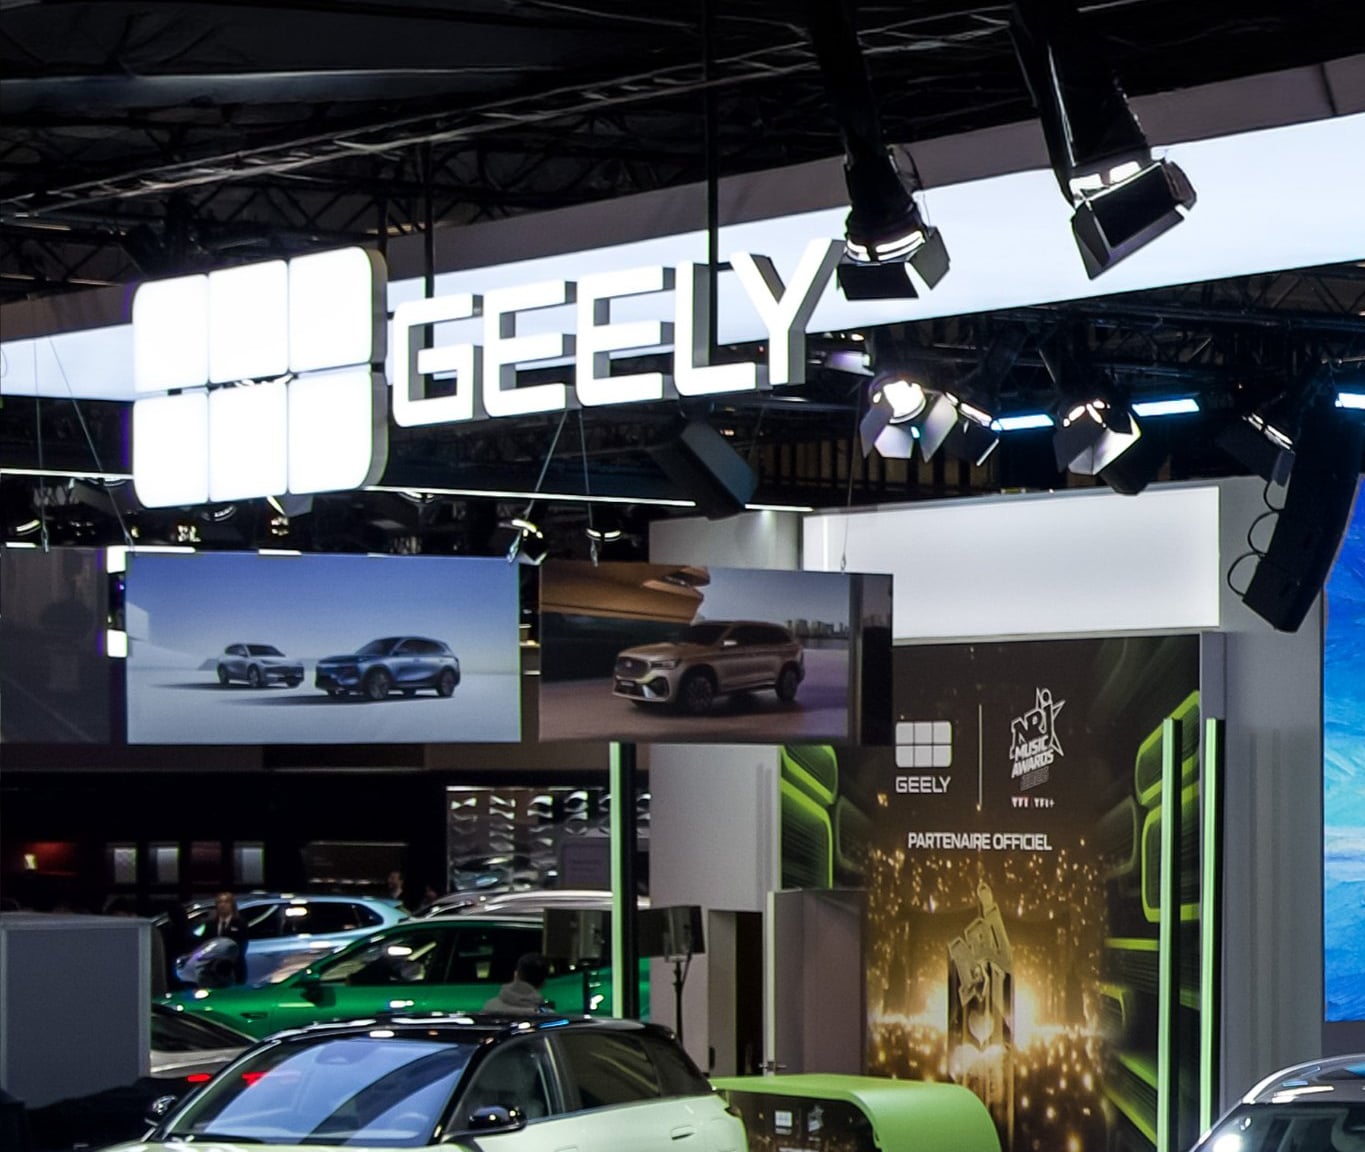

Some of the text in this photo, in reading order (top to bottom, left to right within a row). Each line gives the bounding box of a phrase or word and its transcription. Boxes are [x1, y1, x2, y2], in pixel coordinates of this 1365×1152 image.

[393, 237, 846, 428] GEELY
[1014, 736, 1049, 762] MUSIC
[1010, 750, 1055, 779] AWARDS
[895, 776, 951, 793] GEELY
[907, 832, 1053, 851] PARTENAIRE OFFICIEL
